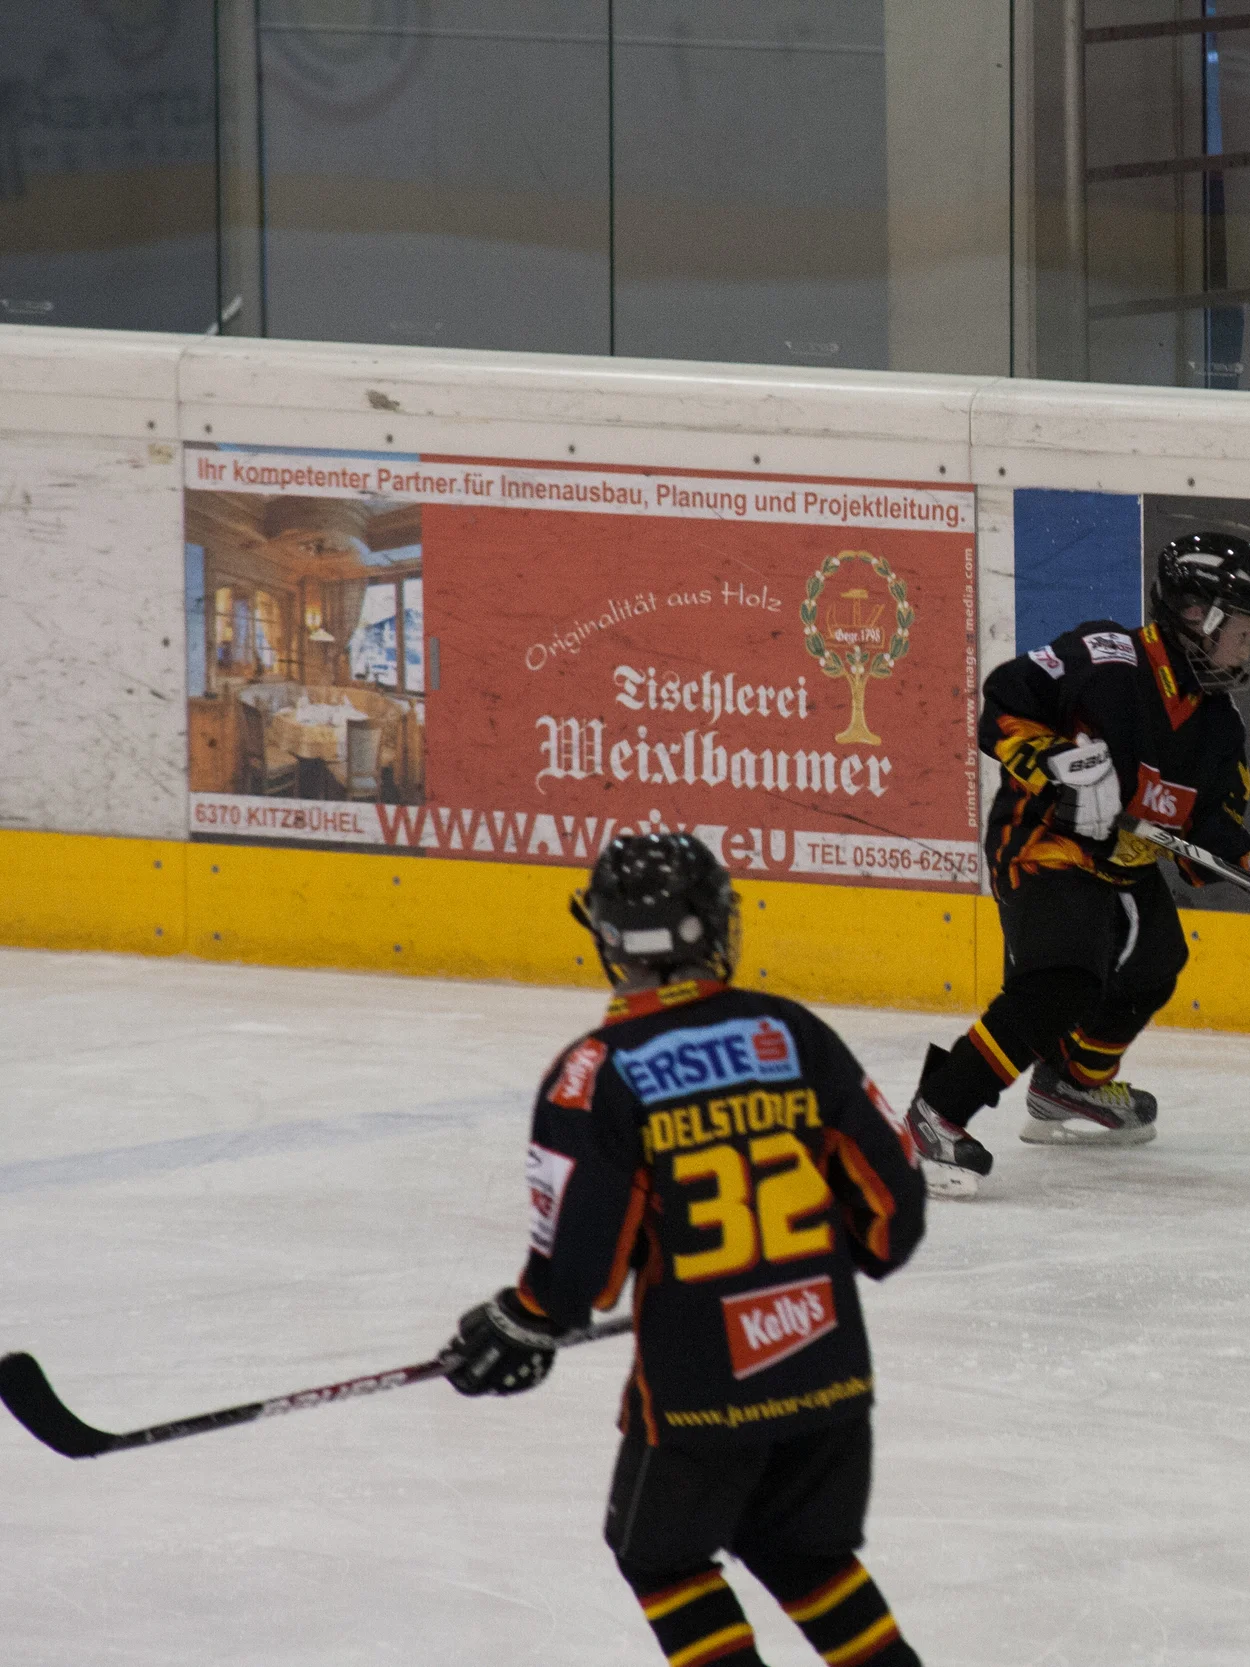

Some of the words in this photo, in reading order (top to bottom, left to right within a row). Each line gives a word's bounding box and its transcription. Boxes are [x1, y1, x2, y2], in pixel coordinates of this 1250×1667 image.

[198, 457, 226, 480] Ihr
[232, 460, 370, 489] kompetenter
[377, 467, 456, 494] Partner
[463, 473, 492, 496] für
[501, 475, 649, 509] Innenausbau,
[656, 484, 748, 516] Planung
[754, 491, 797, 514] und
[803, 491, 965, 528] Projektleitung.
[525, 592, 657, 671] Originalität
[667, 589, 712, 607] aus
[721, 581, 782, 612] Holz
[613, 664, 808, 726] Tischlerei
[535, 715, 893, 798] Weixlbaumer
[195, 803, 241, 826] 6370
[247, 805, 365, 834] KITZBÜHEL
[808, 843, 847, 866] TEL
[853, 845, 979, 874] 05356-62575
[626, 1034, 754, 1098] ERSTE
[672, 1131, 836, 1283] 32
[739, 1290, 826, 1351] Kelly's
